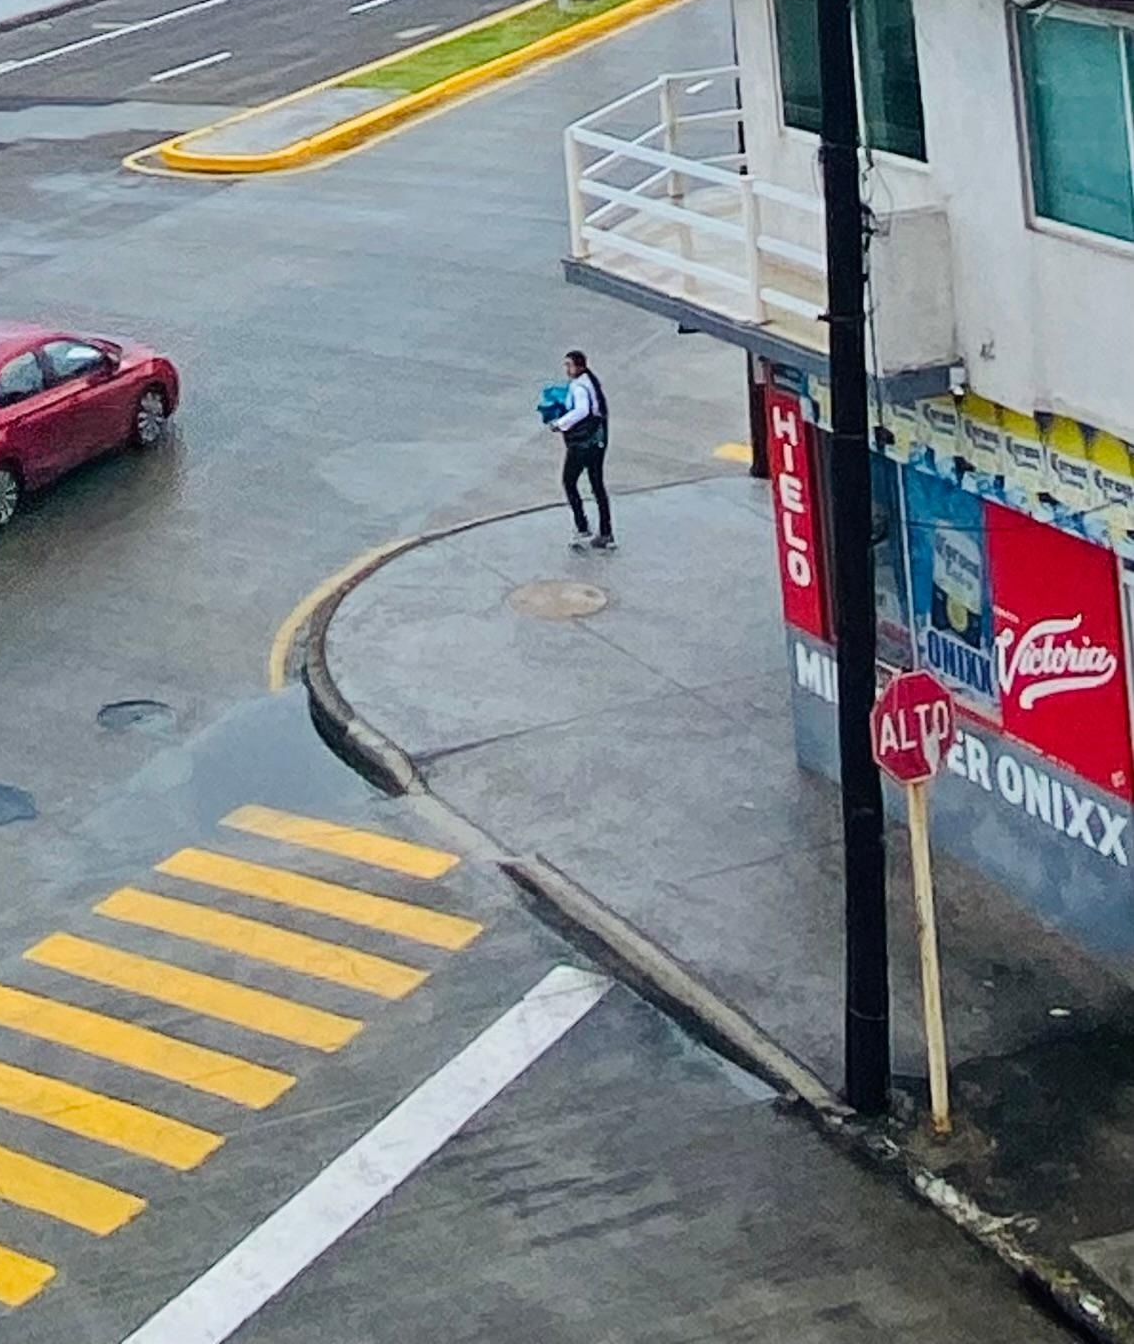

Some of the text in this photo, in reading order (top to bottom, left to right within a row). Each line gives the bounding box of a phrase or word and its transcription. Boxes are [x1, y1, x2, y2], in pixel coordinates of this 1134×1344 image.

[773, 405, 812, 588] HIELO
[995, 613, 1117, 710] Victoria
[879, 700, 949, 755] ALTO
[997, 755, 1128, 866] ONIXX
